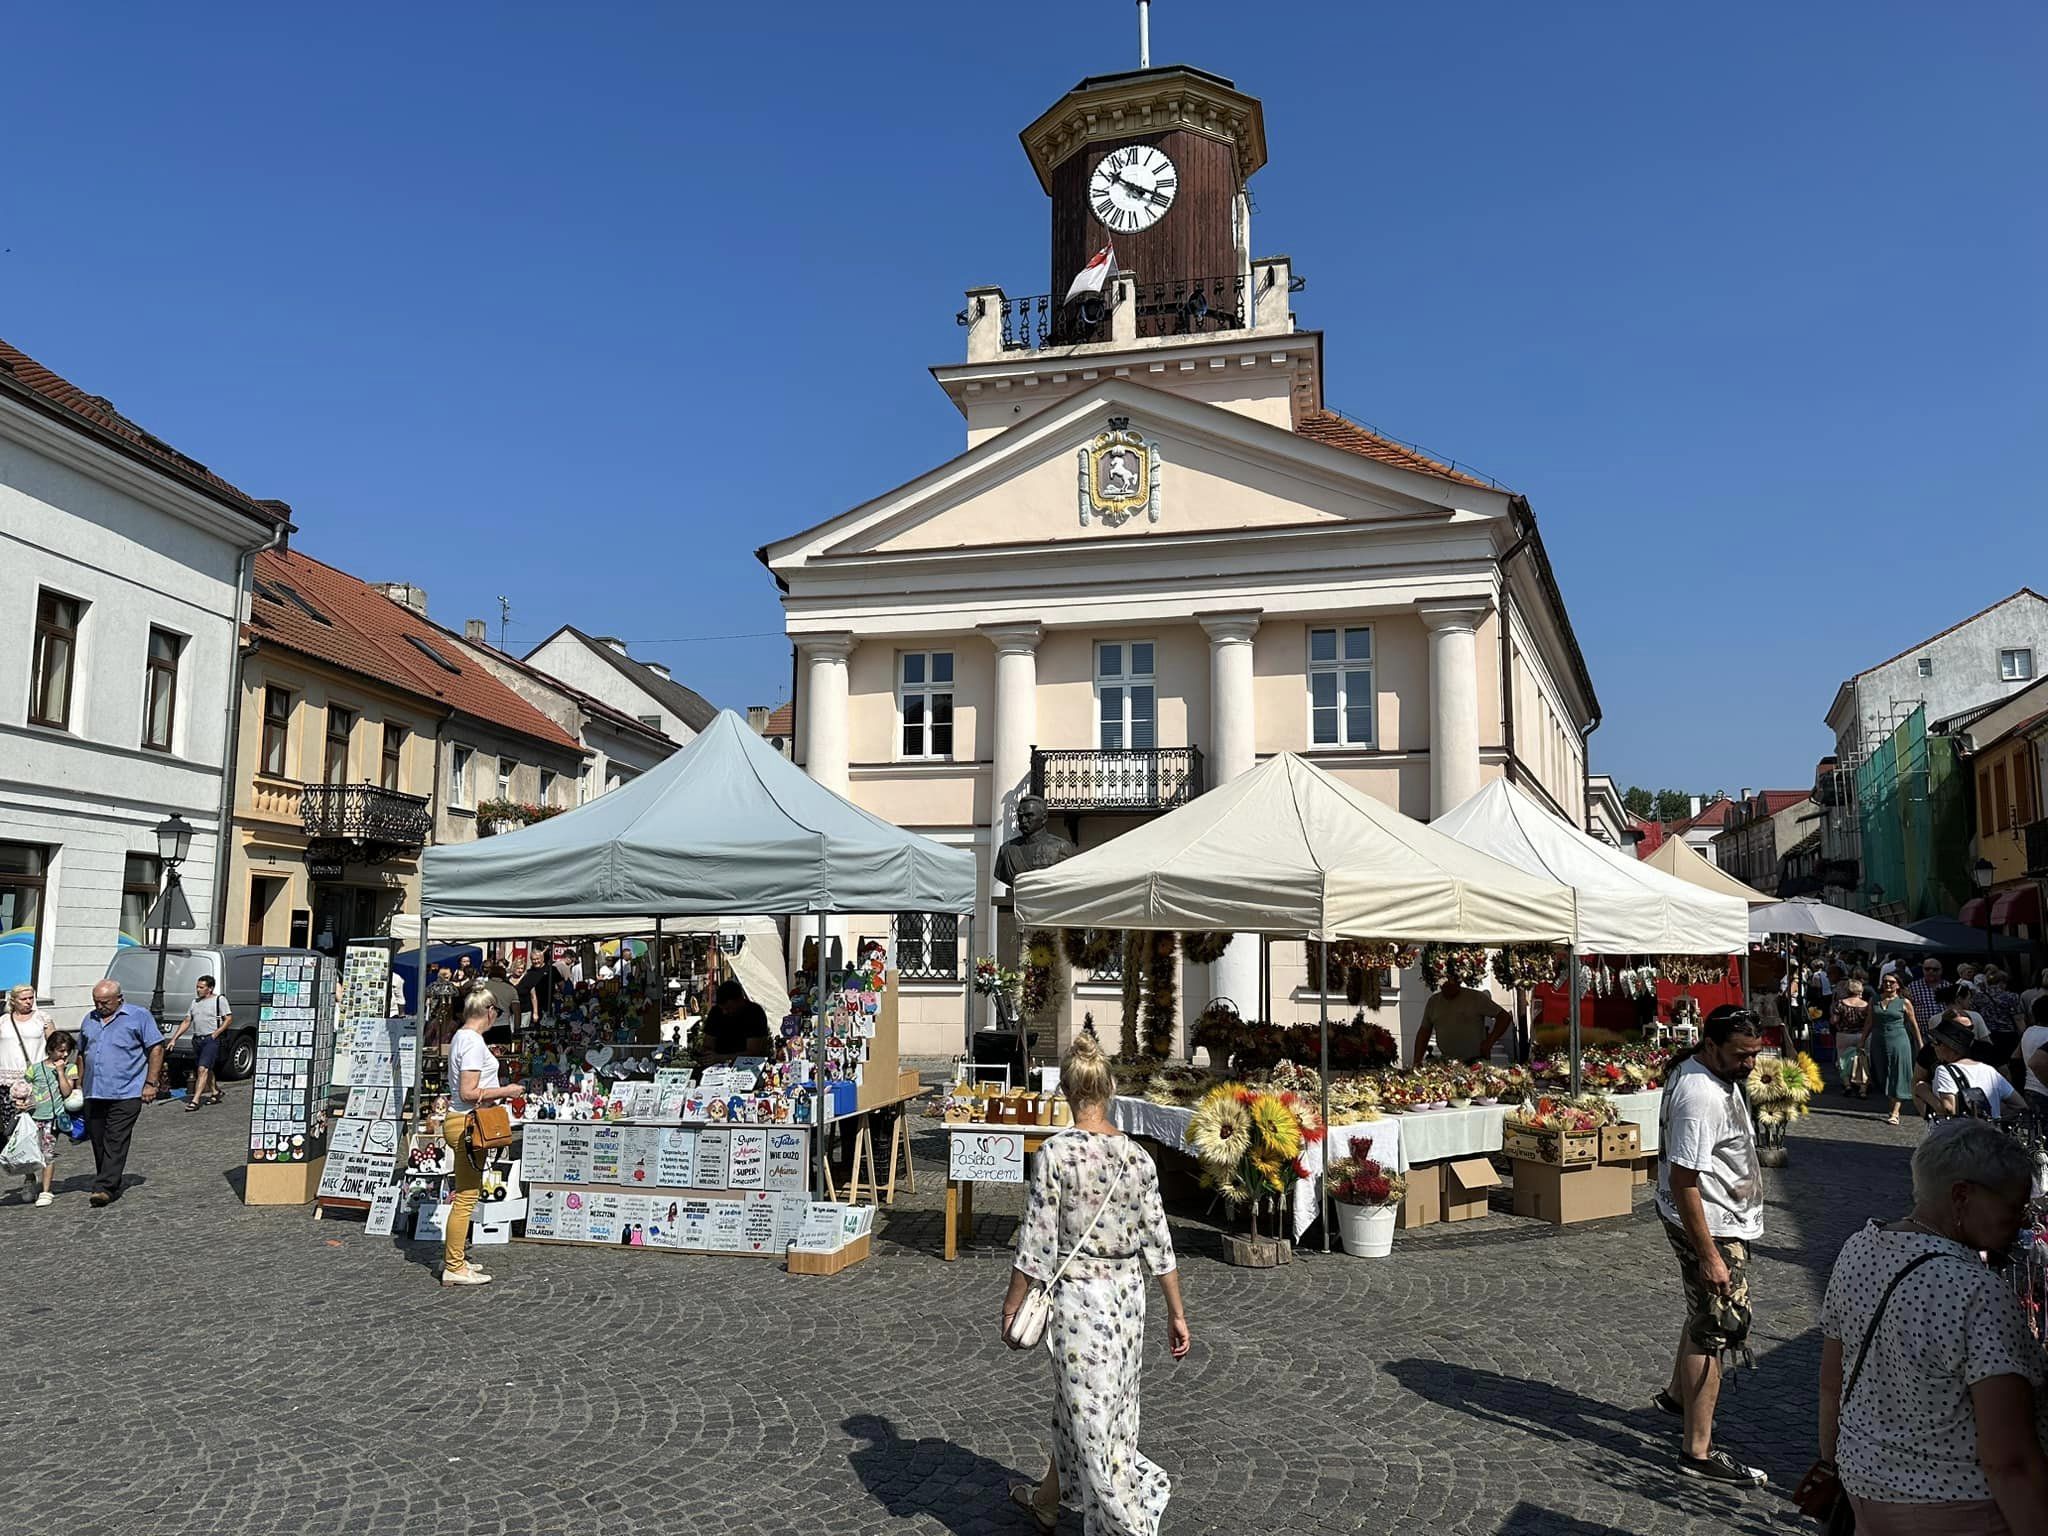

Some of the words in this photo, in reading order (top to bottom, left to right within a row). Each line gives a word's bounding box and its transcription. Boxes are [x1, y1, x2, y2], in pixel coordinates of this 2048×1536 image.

[770, 1152, 781, 1160] WIE
[952, 1139, 995, 1165] Pasieka
[736, 1168, 756, 1176] SUPER
[967, 1166, 1018, 1180] Sercem
